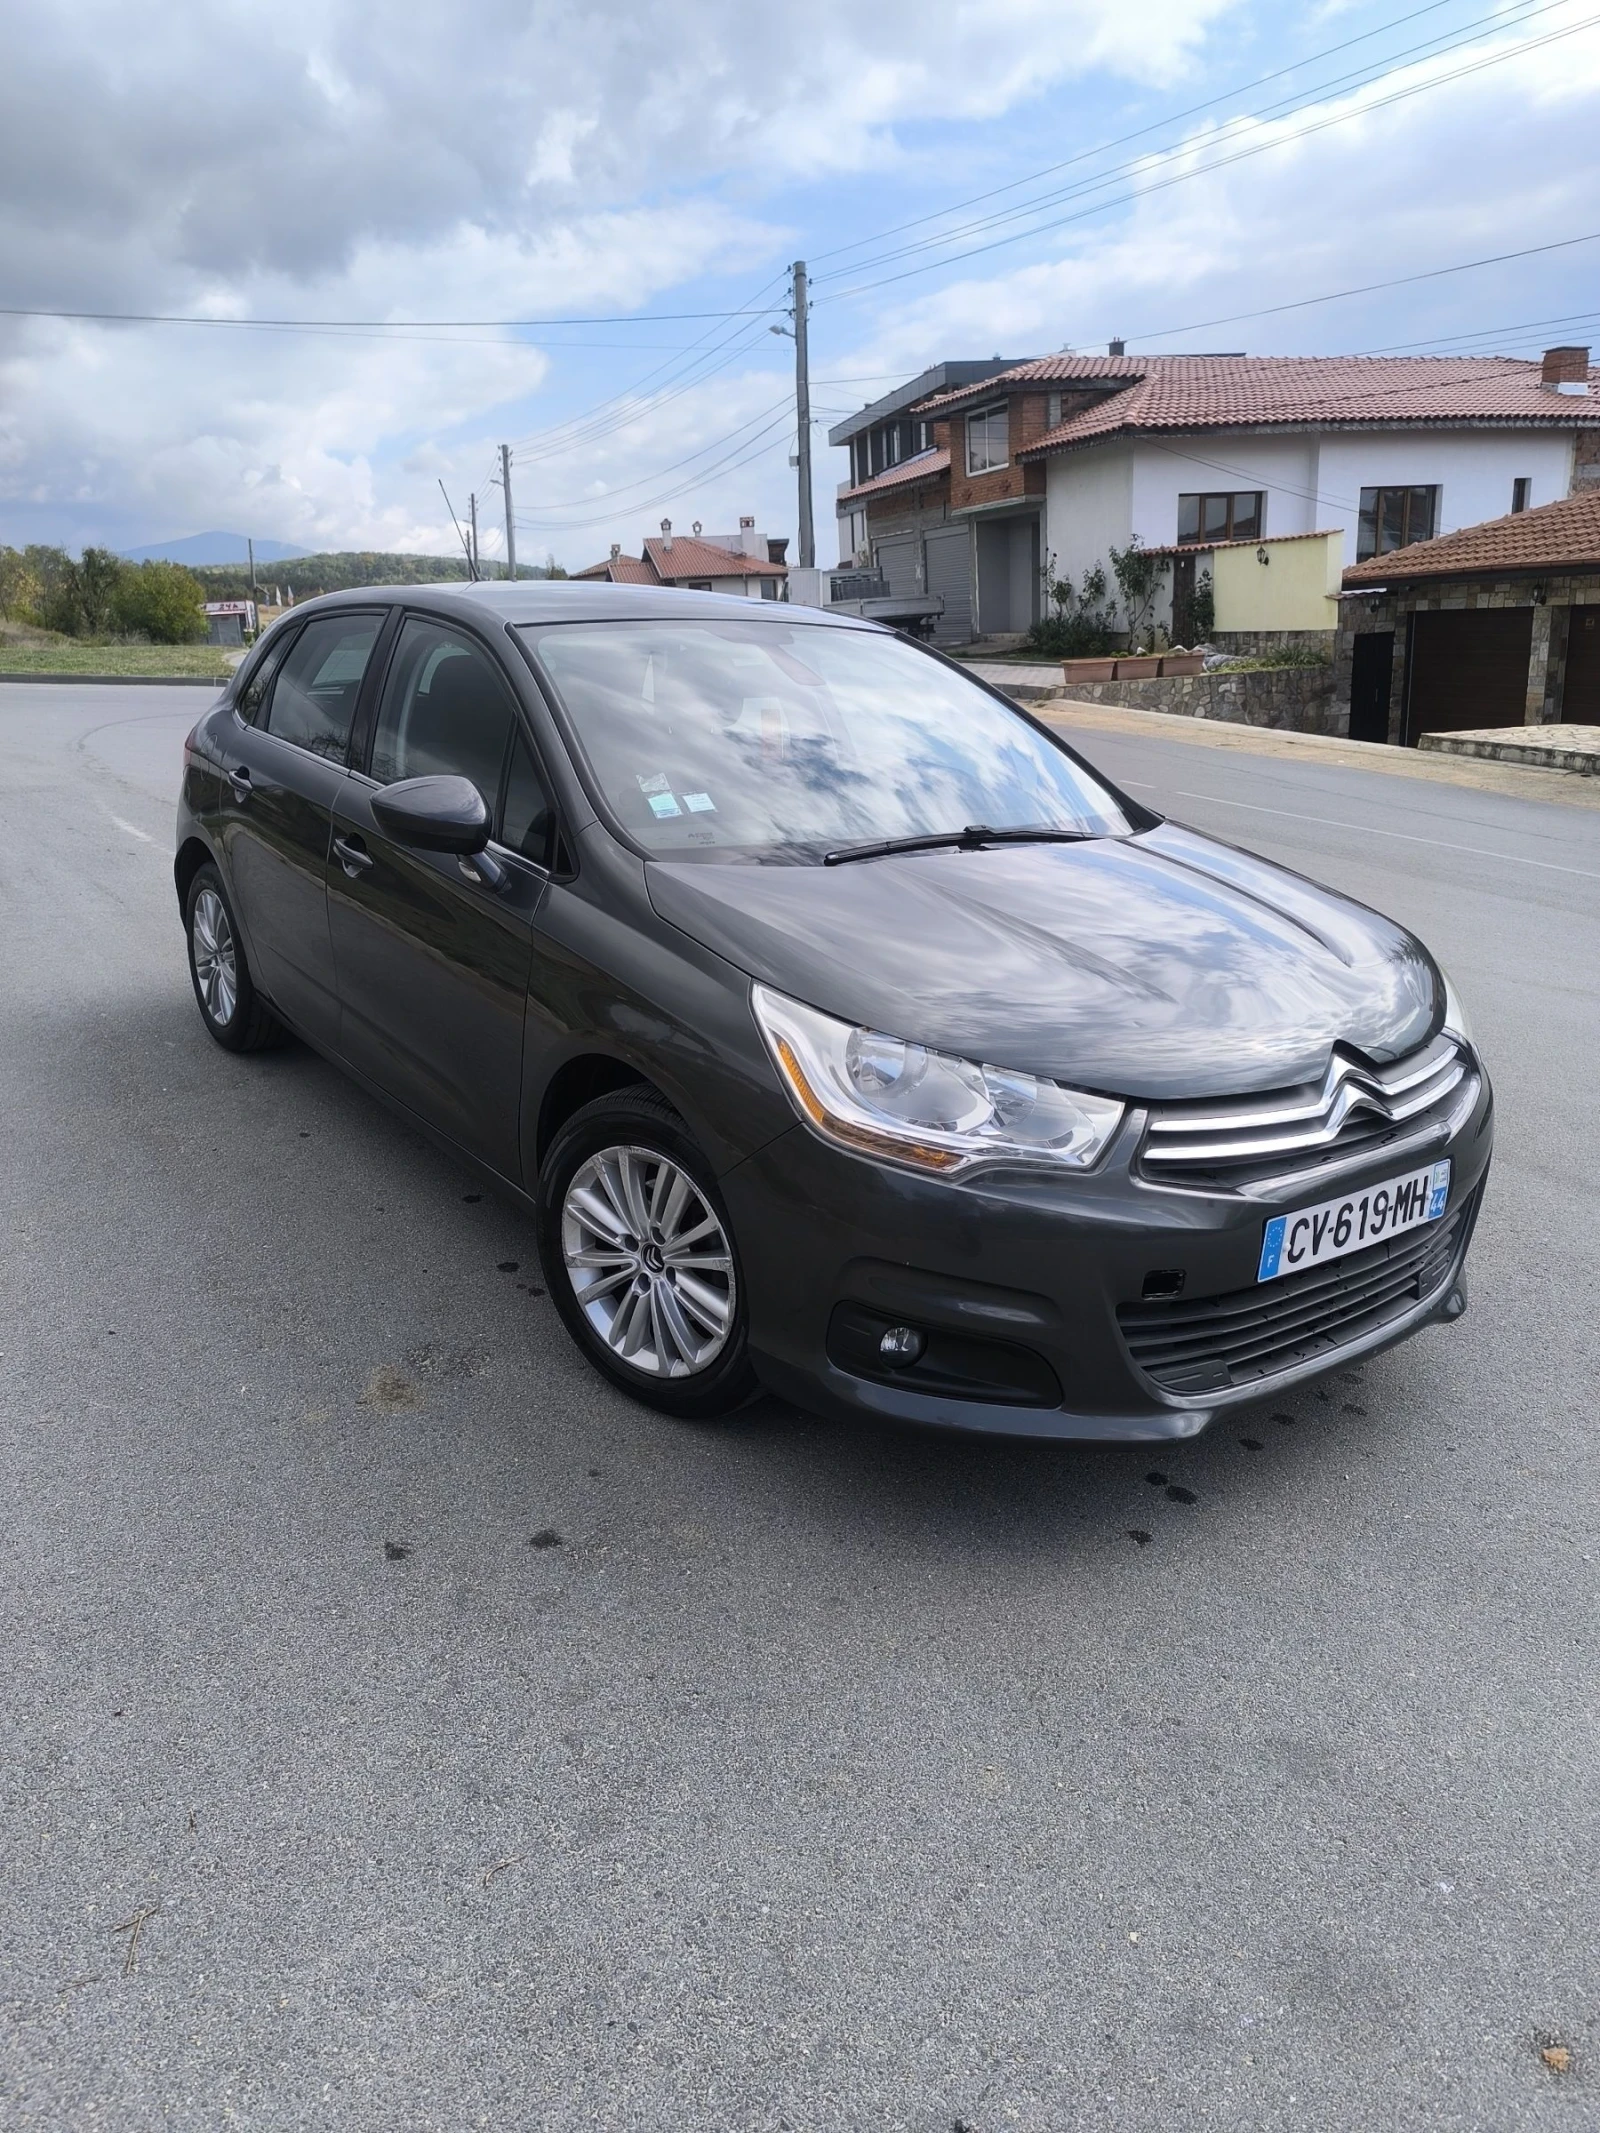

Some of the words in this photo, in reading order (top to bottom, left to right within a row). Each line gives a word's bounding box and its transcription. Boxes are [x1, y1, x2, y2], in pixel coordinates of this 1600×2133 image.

[1430, 1191, 1446, 1213] 44
[1287, 1175, 1429, 1264] CV-619-MH
[1267, 1255, 1274, 1268] F
